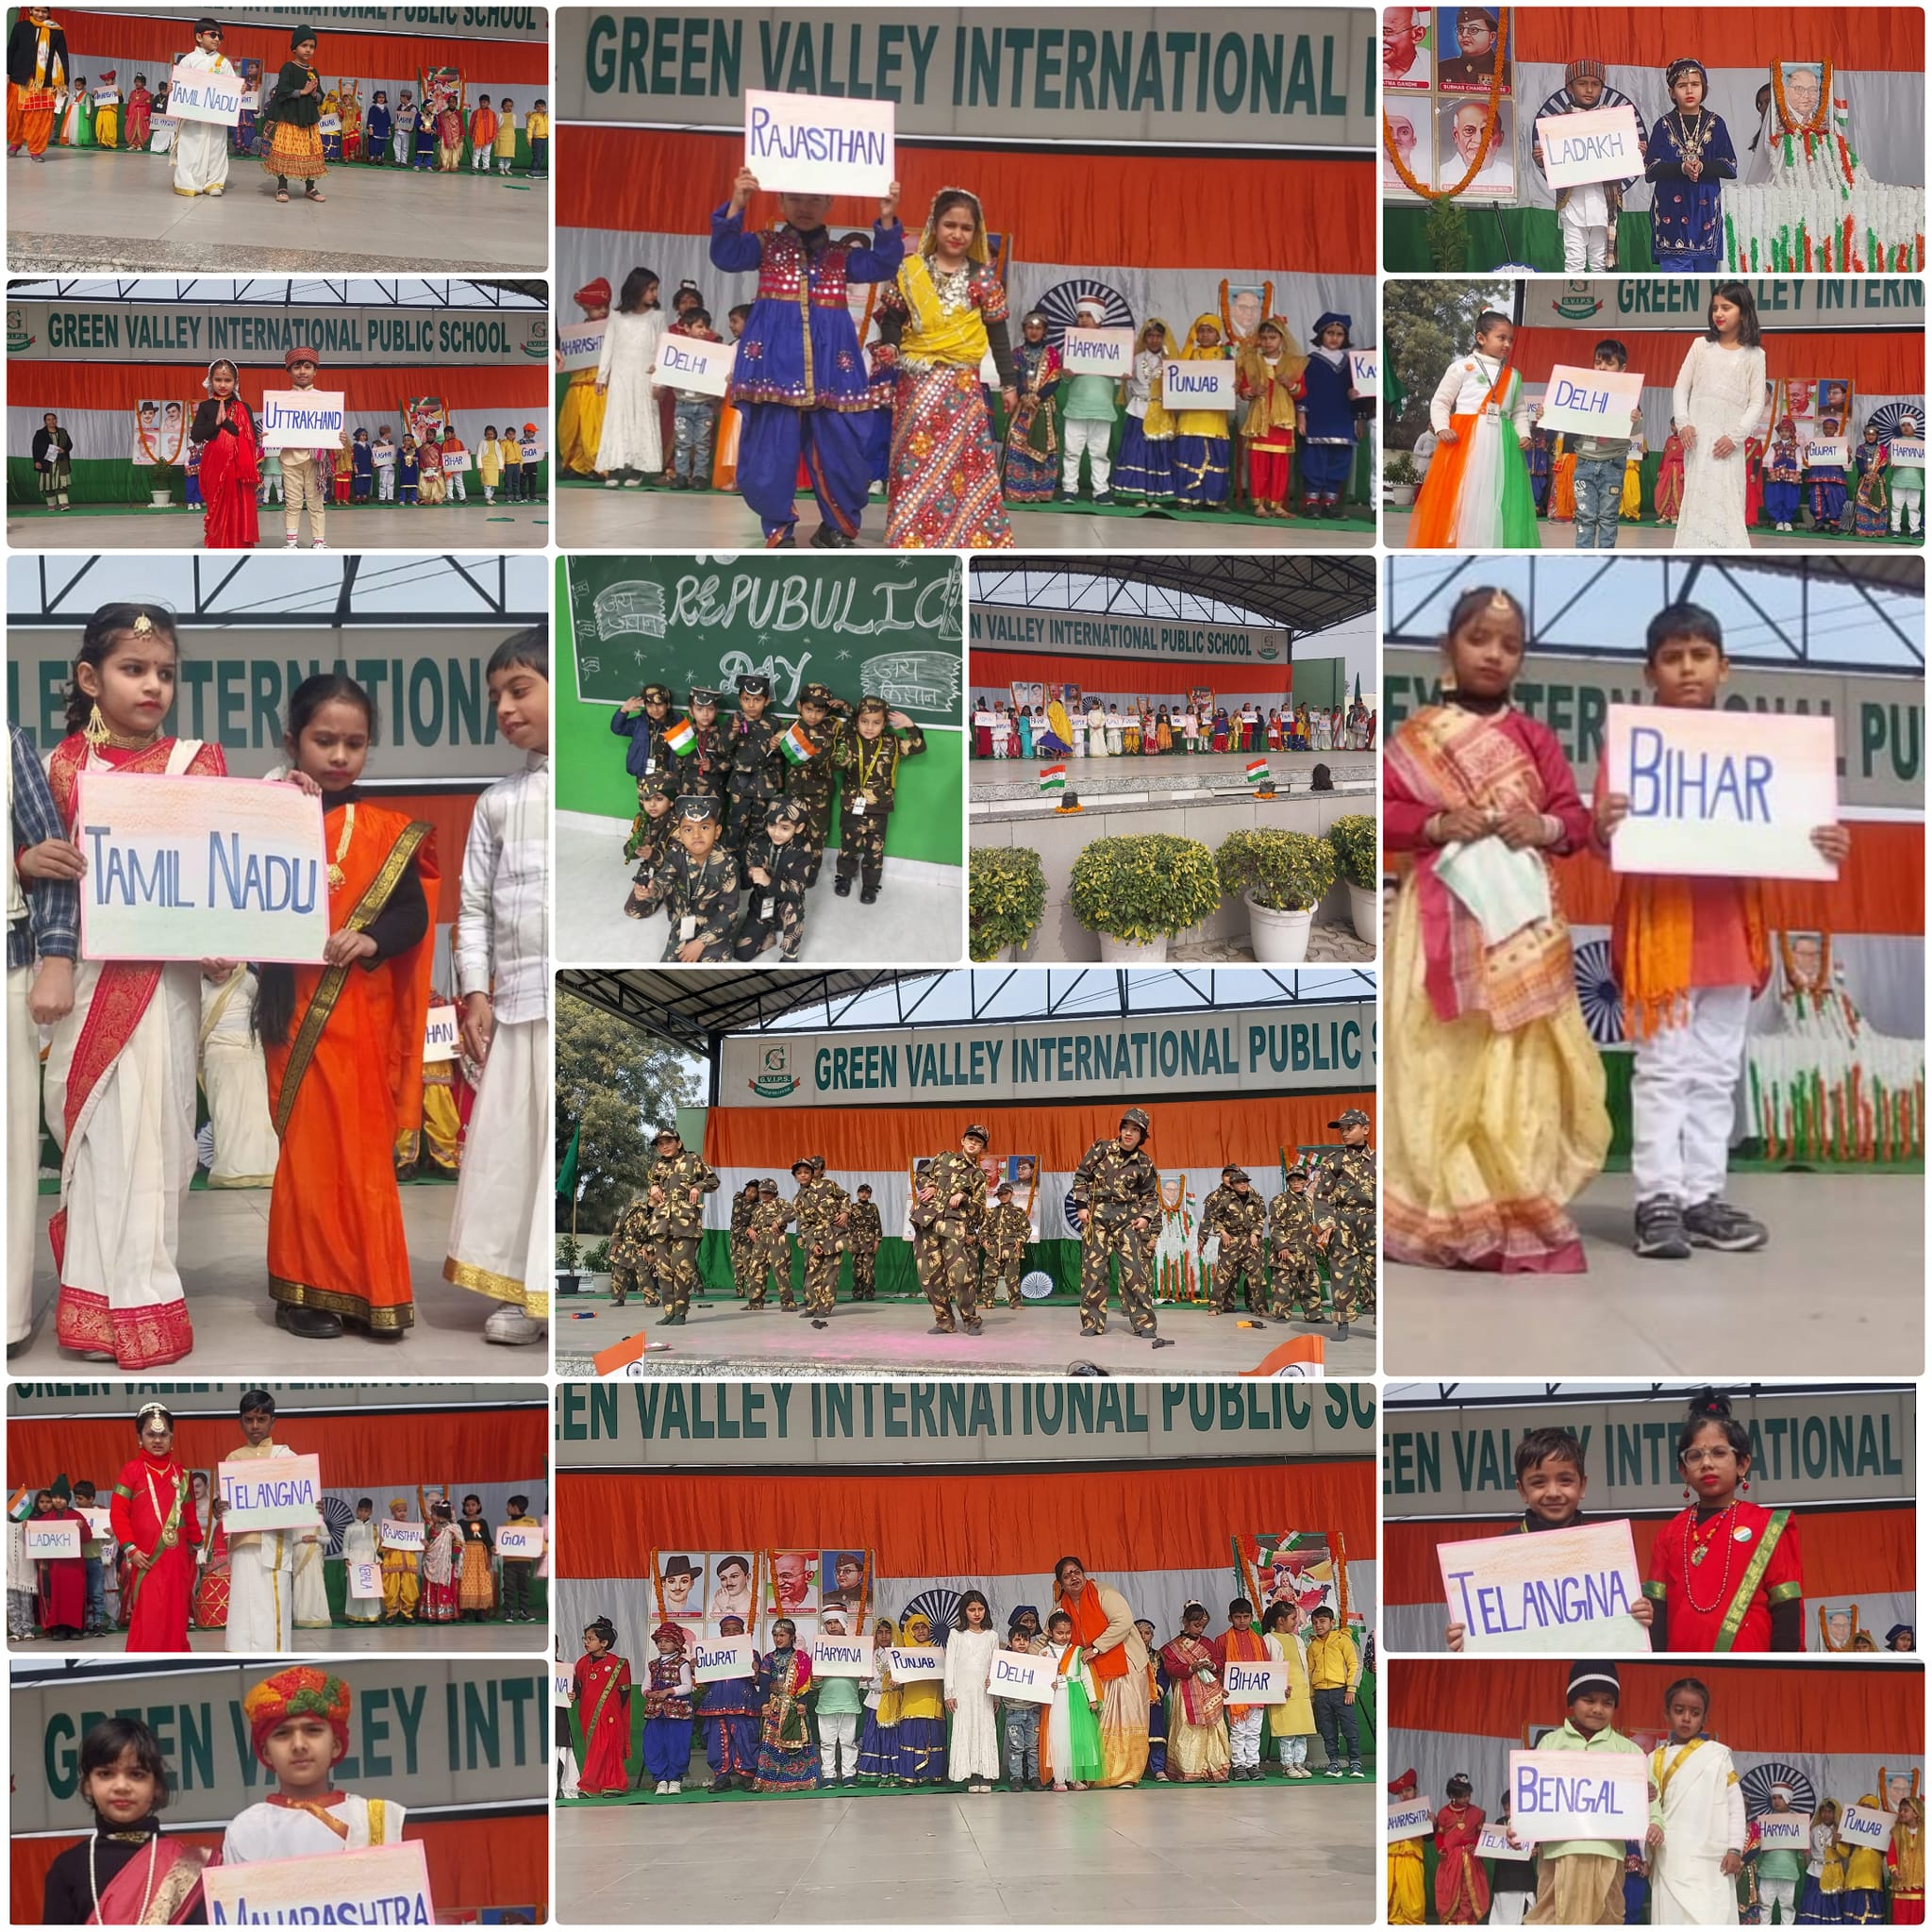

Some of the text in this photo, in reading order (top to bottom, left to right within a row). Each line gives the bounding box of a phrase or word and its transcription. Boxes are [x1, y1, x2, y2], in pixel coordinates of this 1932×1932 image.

[585, 14, 743, 96] GREEN
[758, 20, 940, 106] VALLEY
[952, 25, 1347, 117] INTERNATIONAL
[173, 80, 239, 113] TAMIL NADU
[751, 107, 885, 166] RAJASTHAN
[1544, 132, 1624, 166] LADAKH
[1617, 279, 1699, 313] GREEN
[48, 312, 511, 354] GREEN VALLEY INTERNATIONAL PUBLIC SCHOOL
[1066, 336, 1120, 360] HARYANA
[663, 345, 708, 375] DELHI
[1168, 364, 1219, 392] PUNJAB
[1555, 380, 1609, 414] DELHI
[265, 401, 342, 430] UTTRAKHAND
[444, 455, 463, 467] BIHAR
[1808, 441, 1838, 457] GUJRAT
[986, 615, 1044, 643] VALLEY
[1049, 619, 1158, 650] INTERNATIONAL
[1161, 628, 1204, 653] PUBLIC
[1208, 631, 1252, 656] SCHOOL
[1629, 725, 1774, 824] BIHAR
[85, 825, 317, 914] TAMIL NADU
[814, 1044, 897, 1091] GREEN
[906, 1040, 1004, 1087] VALLEY
[1011, 1027, 1240, 1083] INTERNATIONAL
[1249, 1020, 1362, 1074] PUBLIC
[634, 1383, 793, 1440] VALLEY
[811, 1383, 1149, 1439] INTERNATIONAL
[1162, 1383, 1311, 1432] PUBLIC
[1606, 1413, 1903, 1487] INTEATIONAL
[222, 1475, 314, 1510] TELANGNA
[28, 1529, 71, 1547] LADAKH
[1448, 1569, 1630, 1638] TELANGNA
[695, 1645, 738, 1669] GUJRAT
[815, 1641, 862, 1663] HARYANA
[891, 1651, 935, 1669] PUNJAB
[996, 1660, 1035, 1685] DELHI
[1229, 1667, 1271, 1690] BIHAR
[1517, 1764, 1624, 1816] BENGAL
[1758, 1821, 1800, 1838] HARYANA
[1843, 1807, 1883, 1836] PUNJAB
